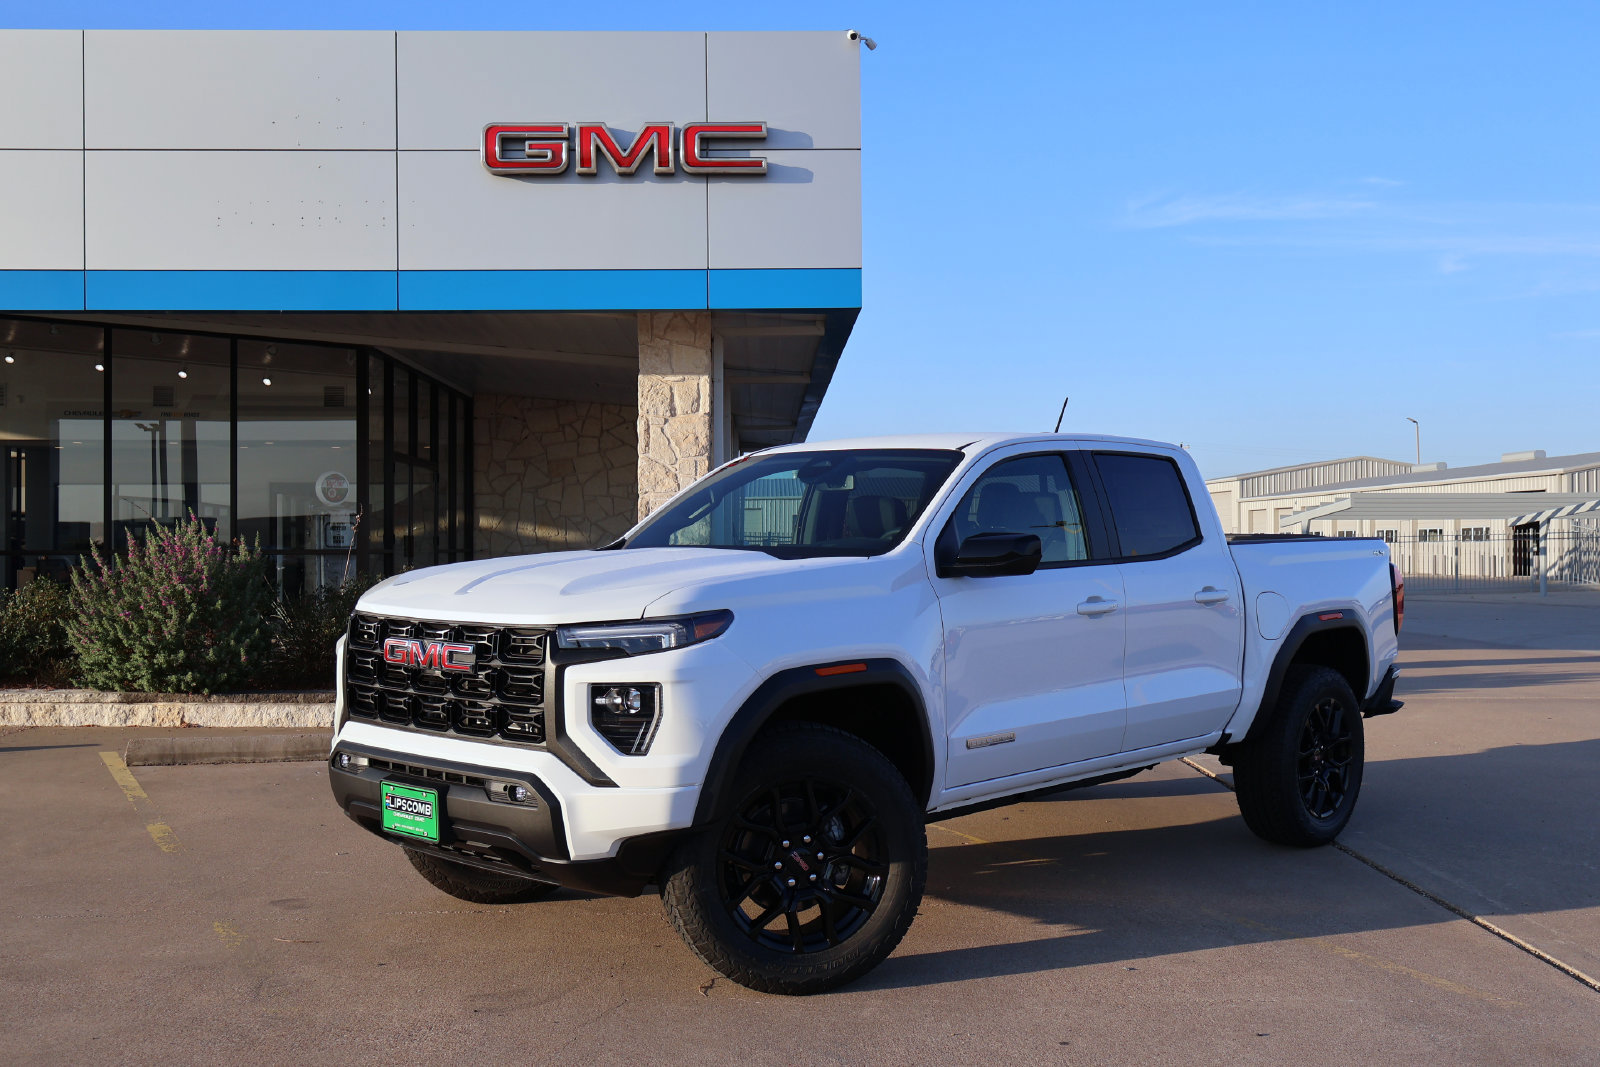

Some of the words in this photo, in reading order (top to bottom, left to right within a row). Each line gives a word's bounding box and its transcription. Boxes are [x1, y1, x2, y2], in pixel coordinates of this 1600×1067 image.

[480, 121, 767, 175] GMC
[383, 637, 476, 674] GMC
[389, 796, 432, 816] LIPSCOMB
